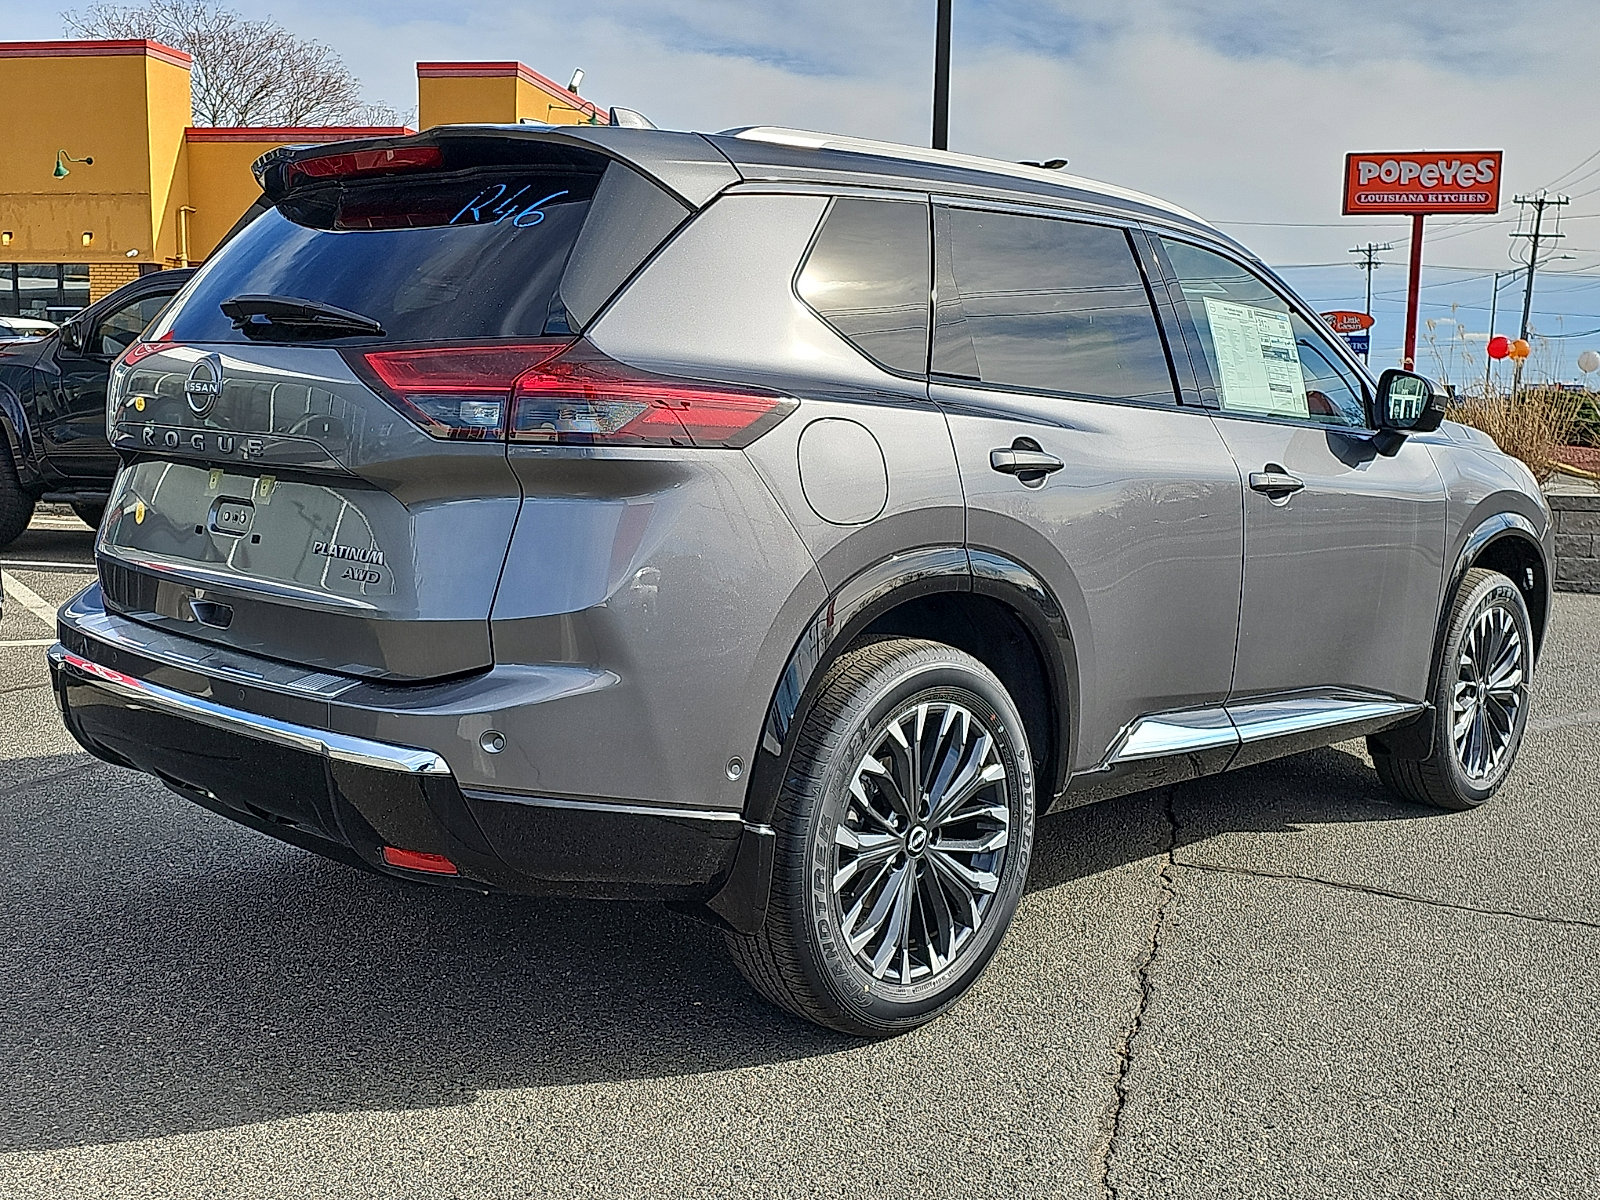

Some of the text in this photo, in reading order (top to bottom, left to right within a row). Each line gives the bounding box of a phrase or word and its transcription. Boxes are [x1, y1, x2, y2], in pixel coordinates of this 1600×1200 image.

[449, 184, 569, 227] R46
[1360, 194, 1487, 203] LOUISIANA KITCHEN
[1343, 316, 1361, 324] Little
[184, 381, 218, 393] NISSAN
[142, 427, 264, 457] ROGUE
[312, 541, 385, 565] PLATINUM
[341, 567, 381, 584] AWD
[1015, 770, 1034, 894] DUNLOP
